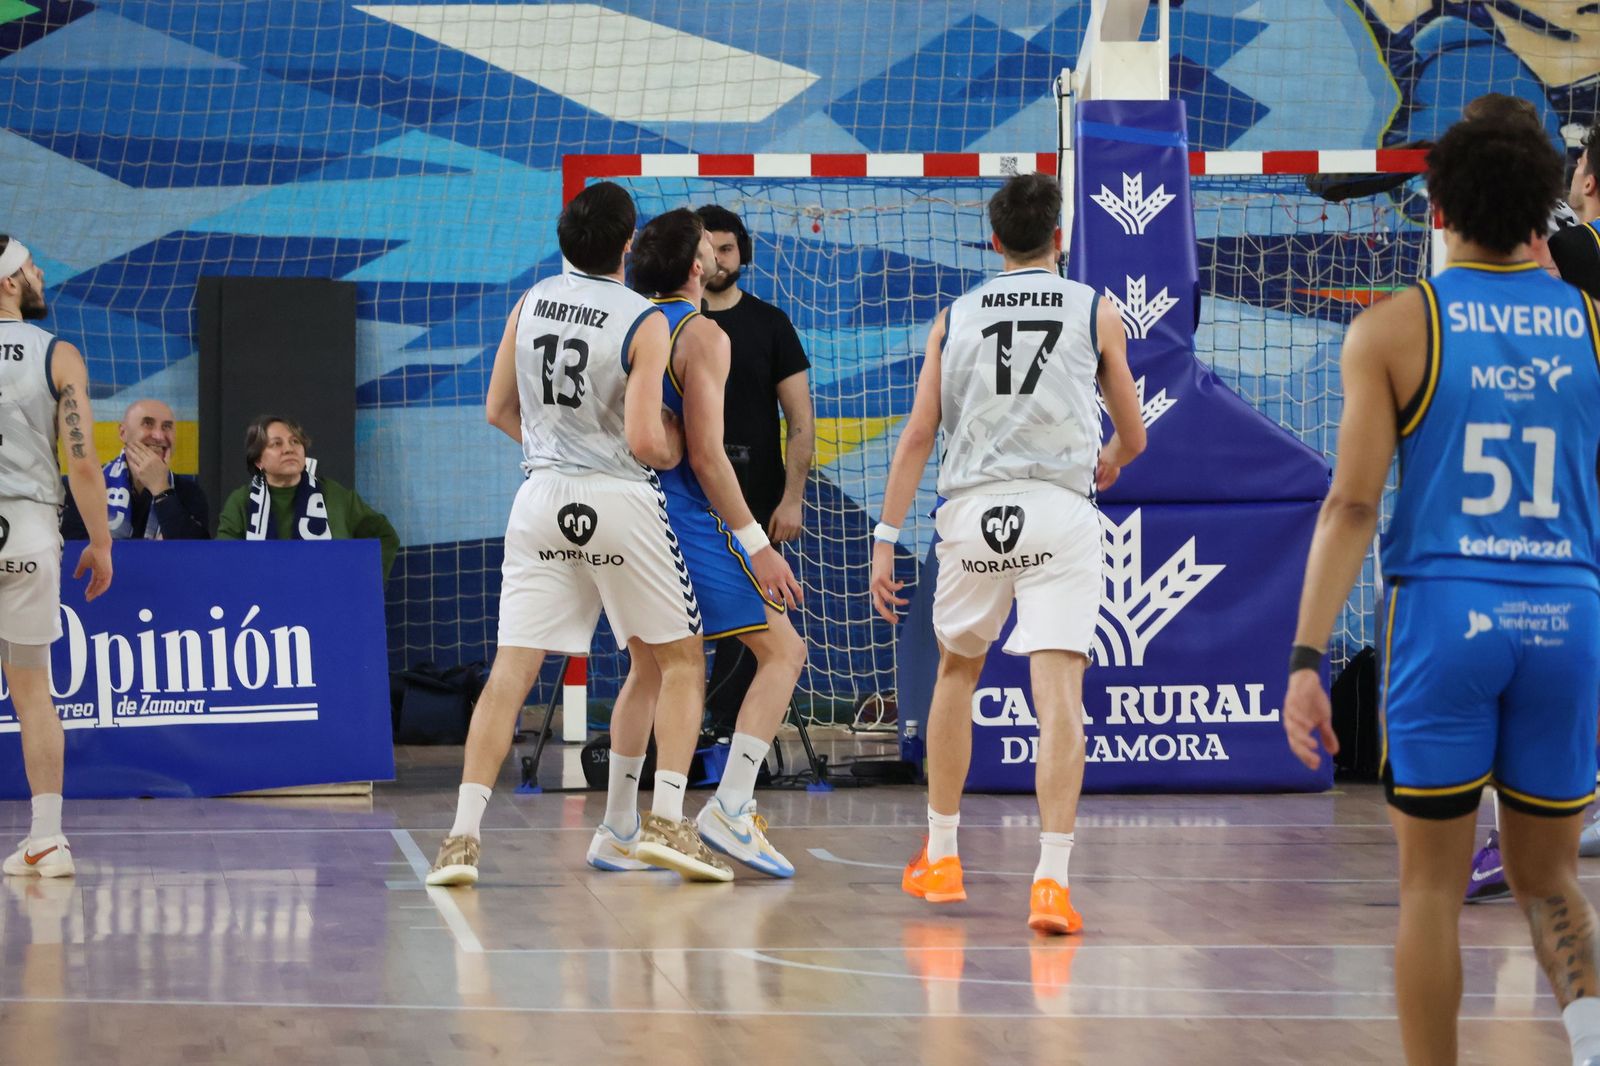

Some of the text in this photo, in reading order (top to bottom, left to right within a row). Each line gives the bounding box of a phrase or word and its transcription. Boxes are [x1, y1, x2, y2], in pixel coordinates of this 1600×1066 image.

[533, 299, 609, 329] MARTÍNEZ
[981, 292, 1064, 308] NASPLER
[1447, 301, 1585, 338] SILVERIO
[0, 343, 25, 361] TS
[981, 320, 1064, 395] 17
[533, 333, 590, 409] 13
[1471, 365, 1536, 390] MGS
[1461, 422, 1560, 519] 51
[48, 603, 317, 728] Opinión
[117, 695, 137, 716] de
[139, 694, 206, 716] Zamora
[1105, 683, 1280, 725] RURAL
[1083, 733, 1230, 763] AMORA
